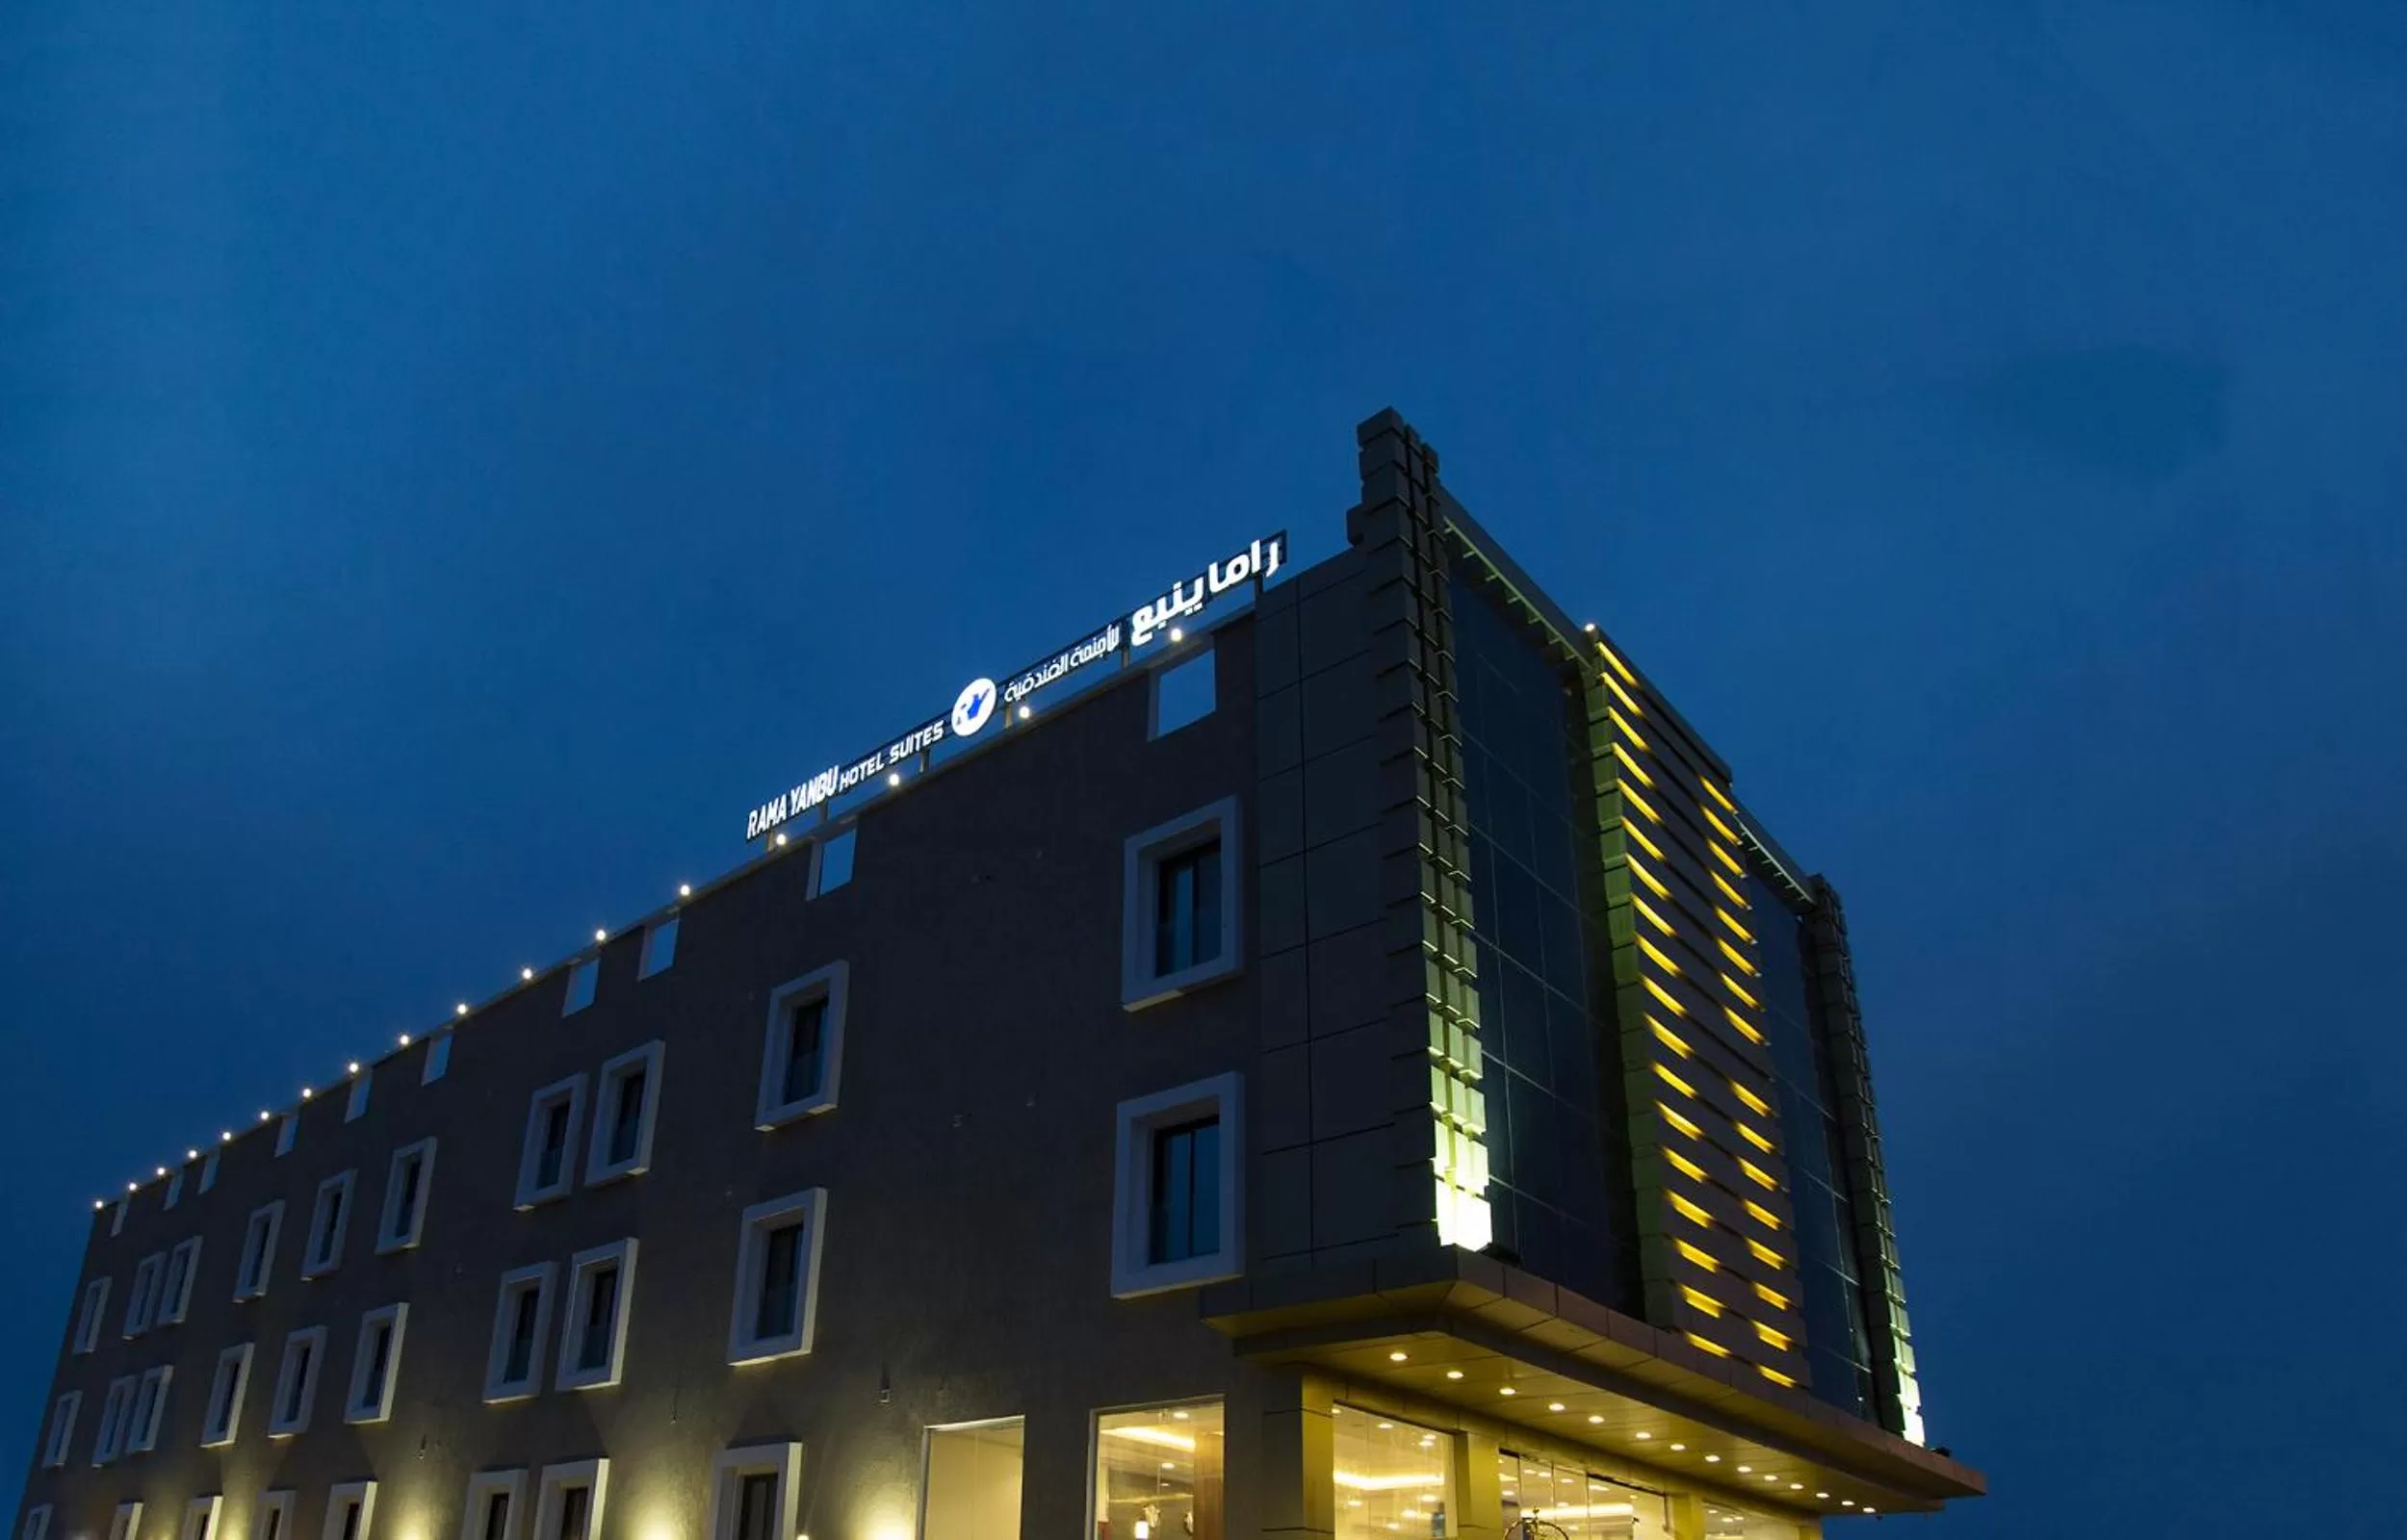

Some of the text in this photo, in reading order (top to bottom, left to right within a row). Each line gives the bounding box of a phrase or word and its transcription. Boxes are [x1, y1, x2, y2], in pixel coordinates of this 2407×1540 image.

[1208, 539, 1279, 594] راما
[1131, 577, 1203, 647] ينبع
[747, 720, 945, 839] RAMA YANBU HOTEL SUITES
